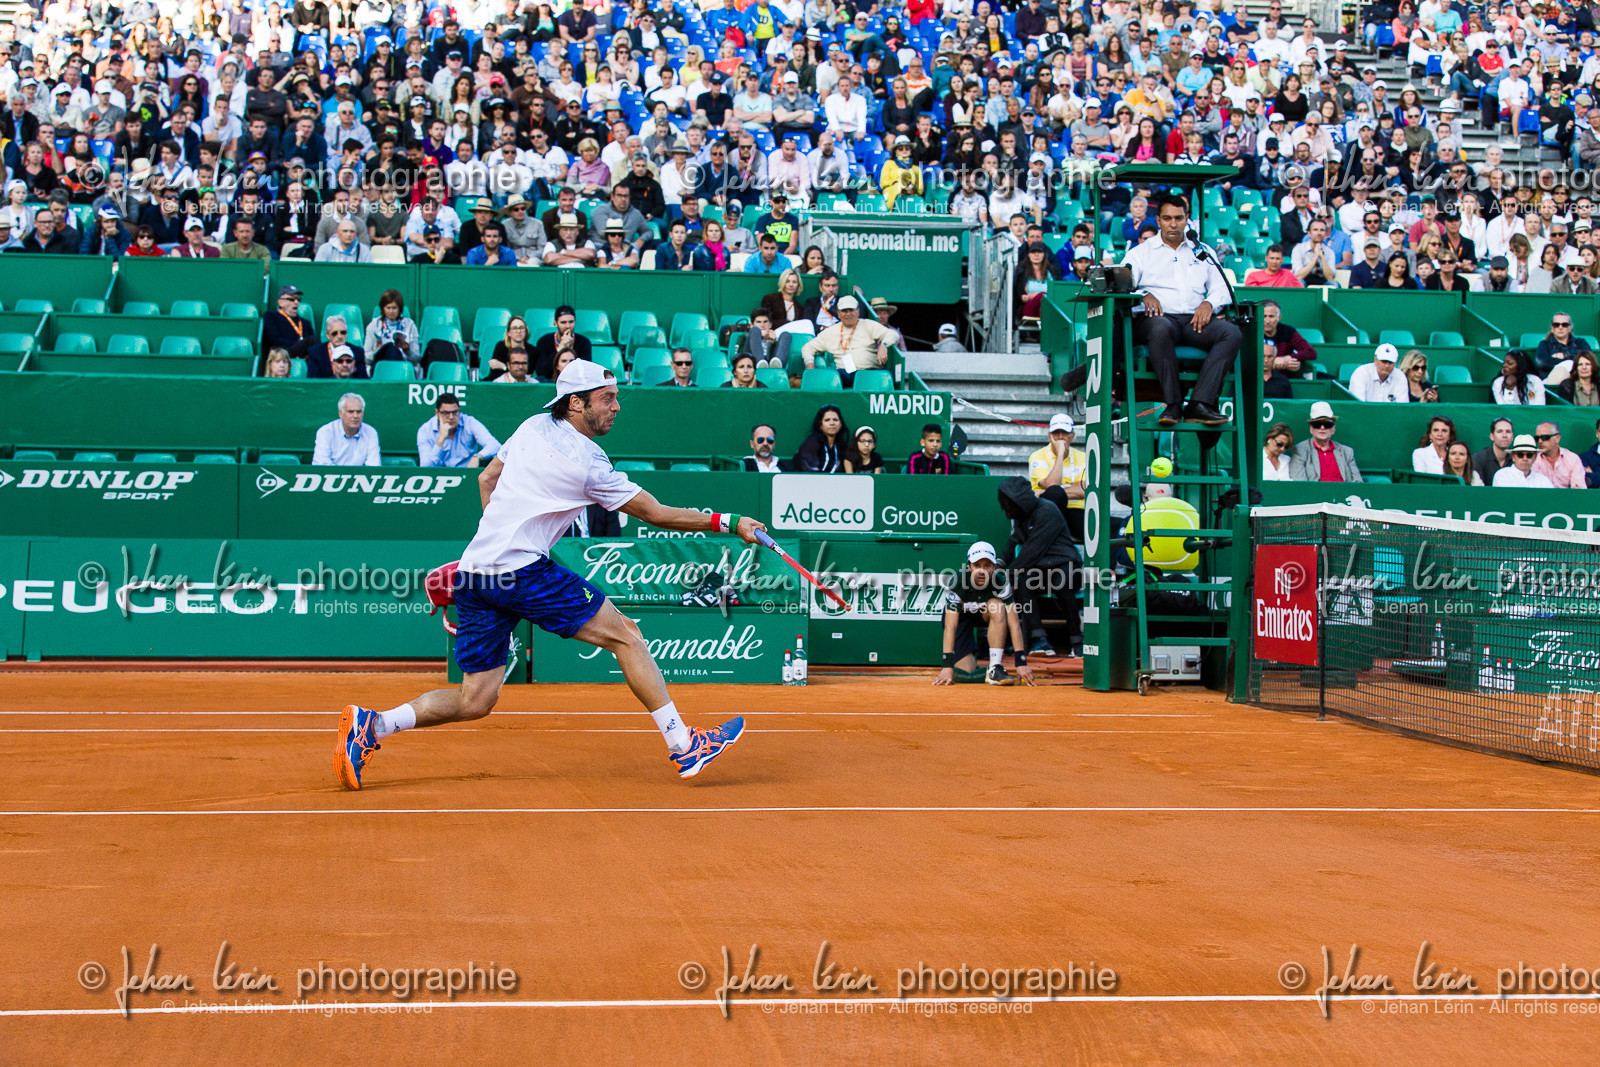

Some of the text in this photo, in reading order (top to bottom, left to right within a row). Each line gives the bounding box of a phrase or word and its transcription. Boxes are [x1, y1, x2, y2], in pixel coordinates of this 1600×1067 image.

[869, 393, 944, 416] MADRID
[16, 469, 195, 490] DUNLOP
[289, 473, 463, 494] DUNLOP
[1083, 336, 1103, 624] RICOH
[102, 491, 174, 501] SPORT
[372, 496, 443, 505] SPORT
[780, 501, 959, 531] Adecco Groupe
[583, 542, 760, 591] Façonnable
[0, 579, 325, 615] EUGEOT
[629, 593, 666, 601] FRENCH
[1274, 567, 1292, 602] Fly
[1256, 598, 1314, 642] Emirates
[579, 618, 764, 661] onnable
[673, 668, 709, 676] RIVIERA
